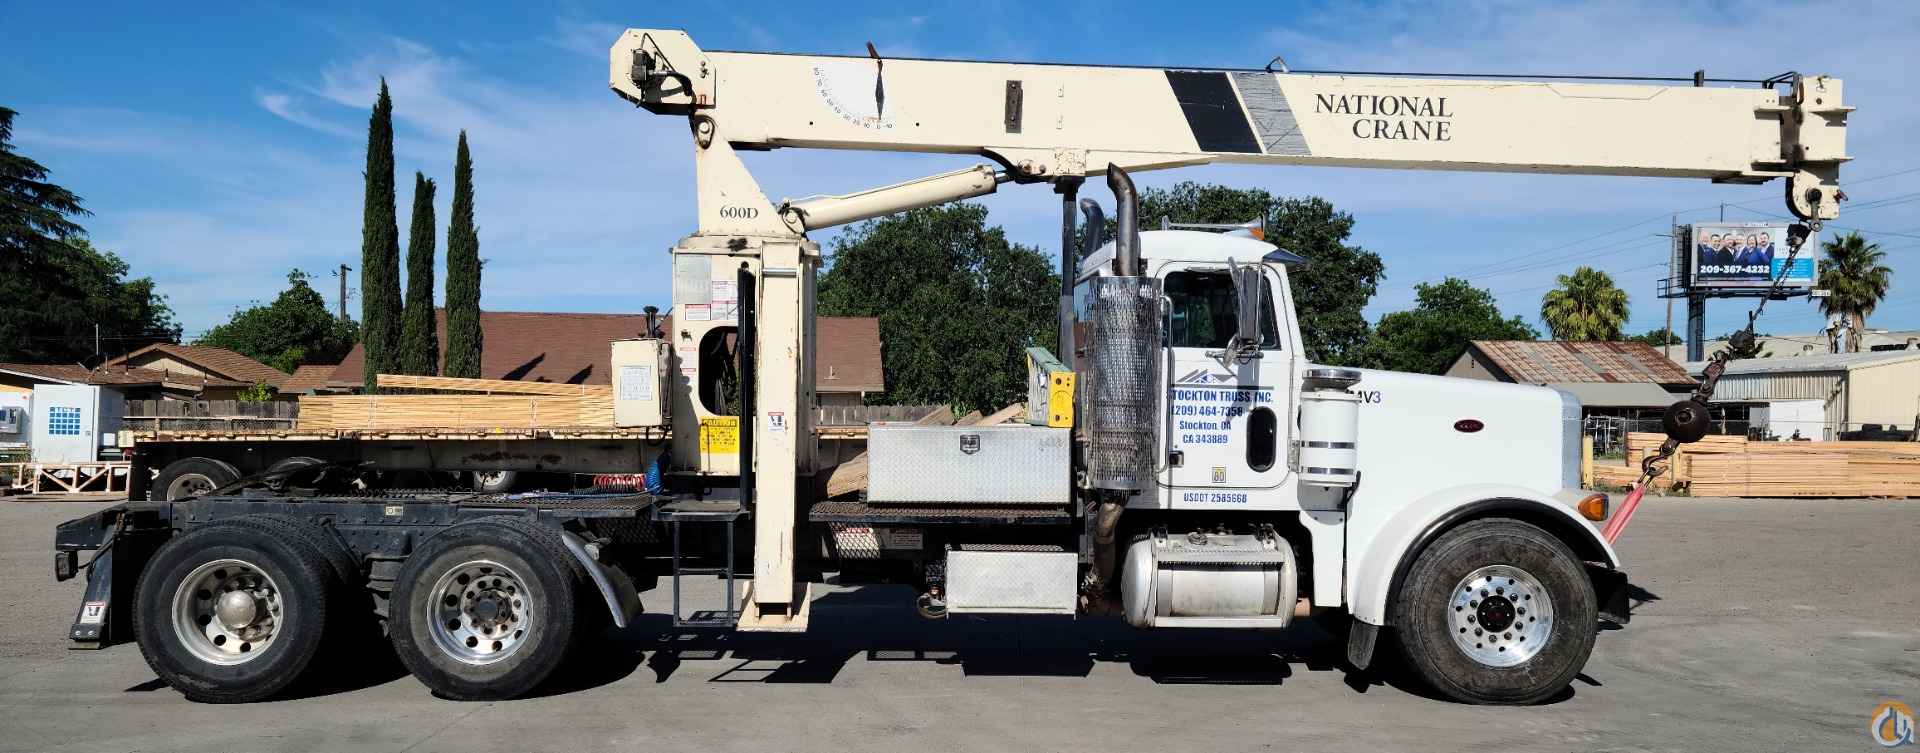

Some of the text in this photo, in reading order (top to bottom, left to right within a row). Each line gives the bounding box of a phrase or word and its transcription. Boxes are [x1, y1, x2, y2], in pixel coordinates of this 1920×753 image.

[1315, 93, 1453, 117] NATIONAL
[1352, 119, 1452, 141] CRANE
[719, 205, 759, 219] 600D
[1700, 264, 1770, 274] 209-367-4232
[1171, 405, 1243, 417] (209) 464-7358
[1221, 421, 1232, 430] CA
[1183, 434, 1194, 444] CA
[1183, 493, 1208, 502] USDOT
